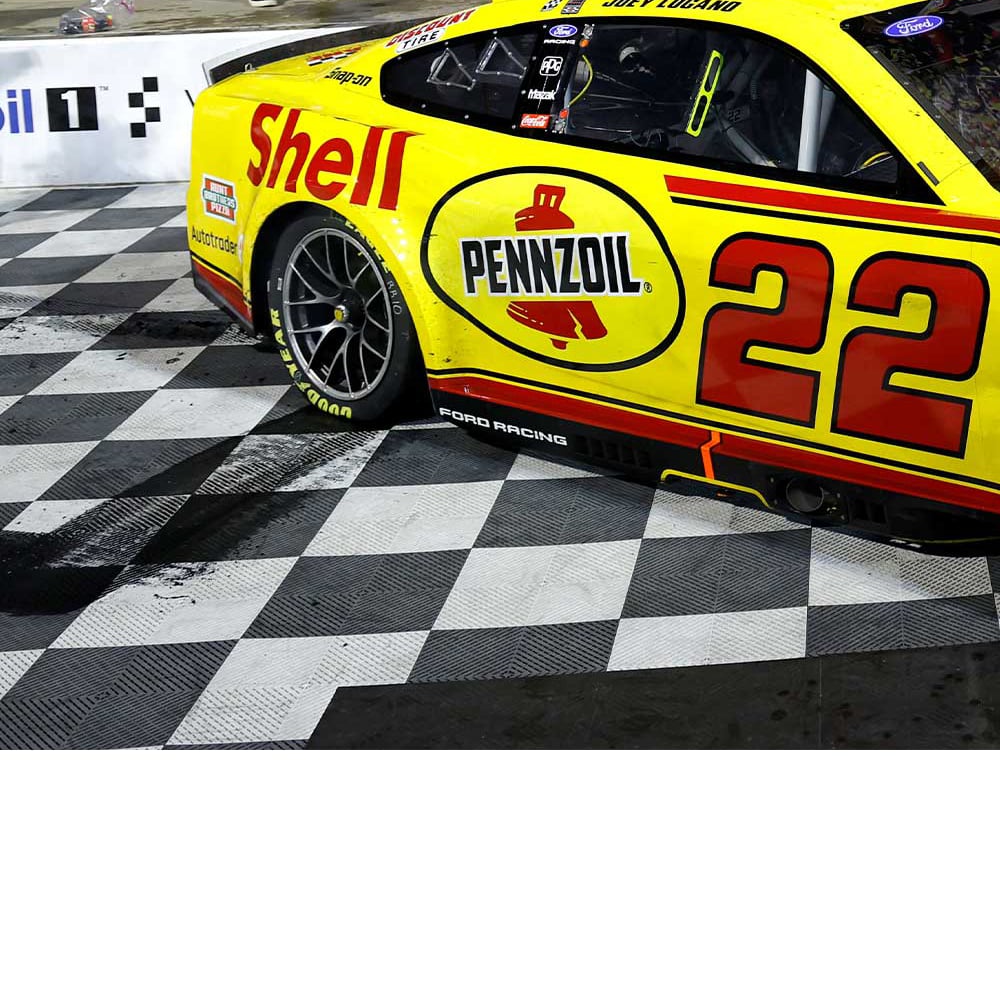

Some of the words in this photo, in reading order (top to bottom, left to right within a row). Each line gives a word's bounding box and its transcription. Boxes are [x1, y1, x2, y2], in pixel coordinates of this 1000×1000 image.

[386, 9, 476, 47] DISCOUNT
[403, 29, 439, 49] TIRE
[899, 17, 934, 34] Ford
[528, 89, 555, 100] Mazak
[247, 102, 424, 211] Shell
[192, 225, 238, 256] Autotrader
[461, 234, 642, 294] PENNZOIL
[695, 231, 990, 460] 22
[439, 407, 490, 429] FORD
[493, 421, 568, 446] RACING
